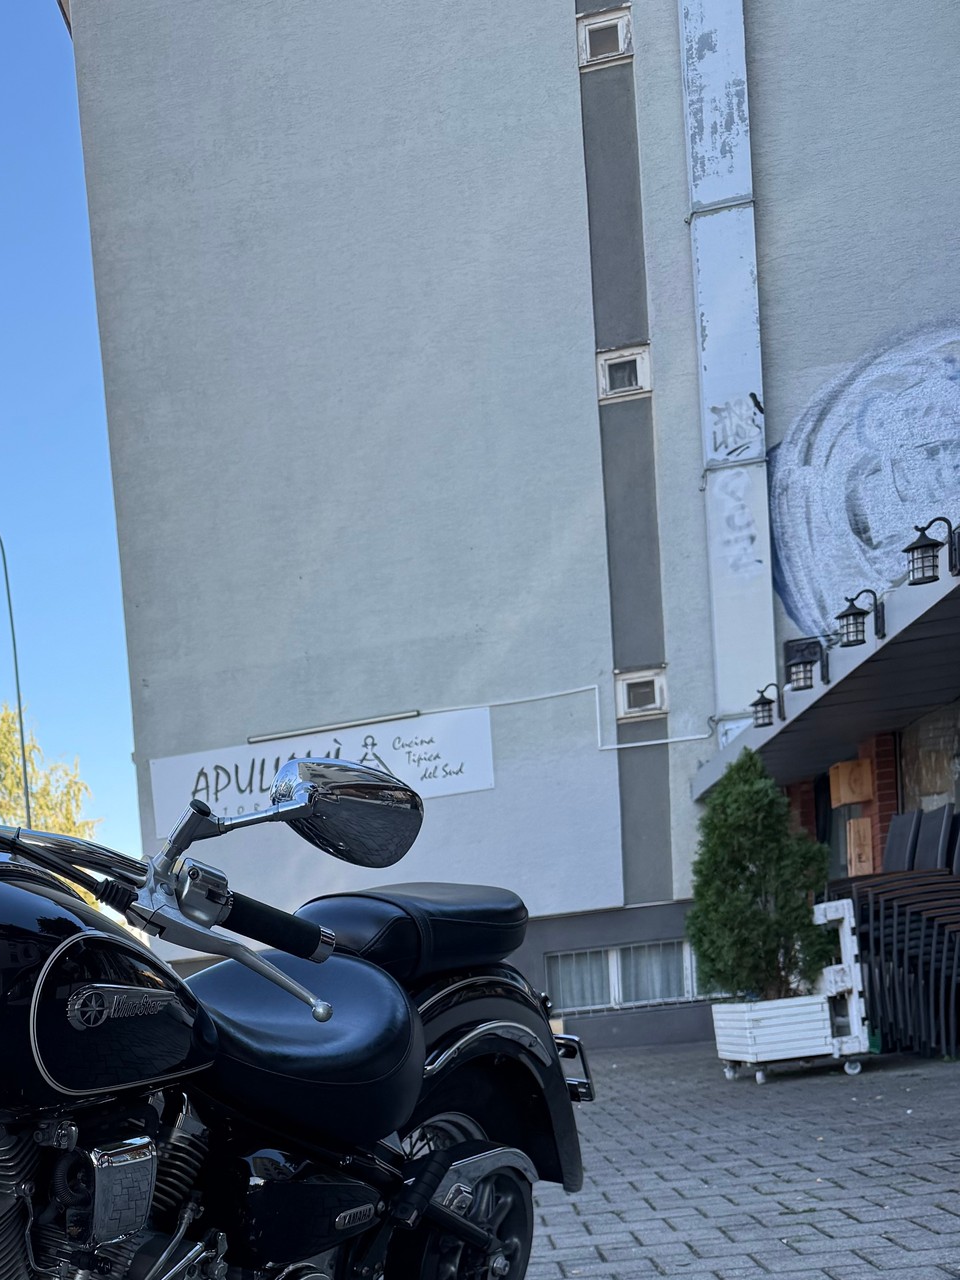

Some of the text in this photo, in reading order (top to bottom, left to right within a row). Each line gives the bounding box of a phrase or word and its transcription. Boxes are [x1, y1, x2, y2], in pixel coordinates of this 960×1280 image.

[392, 736, 436, 751] Cucina
[405, 750, 441, 768] Tipica
[420, 762, 464, 781] del Sud
[343, 1207, 372, 1227] YAMAHA
